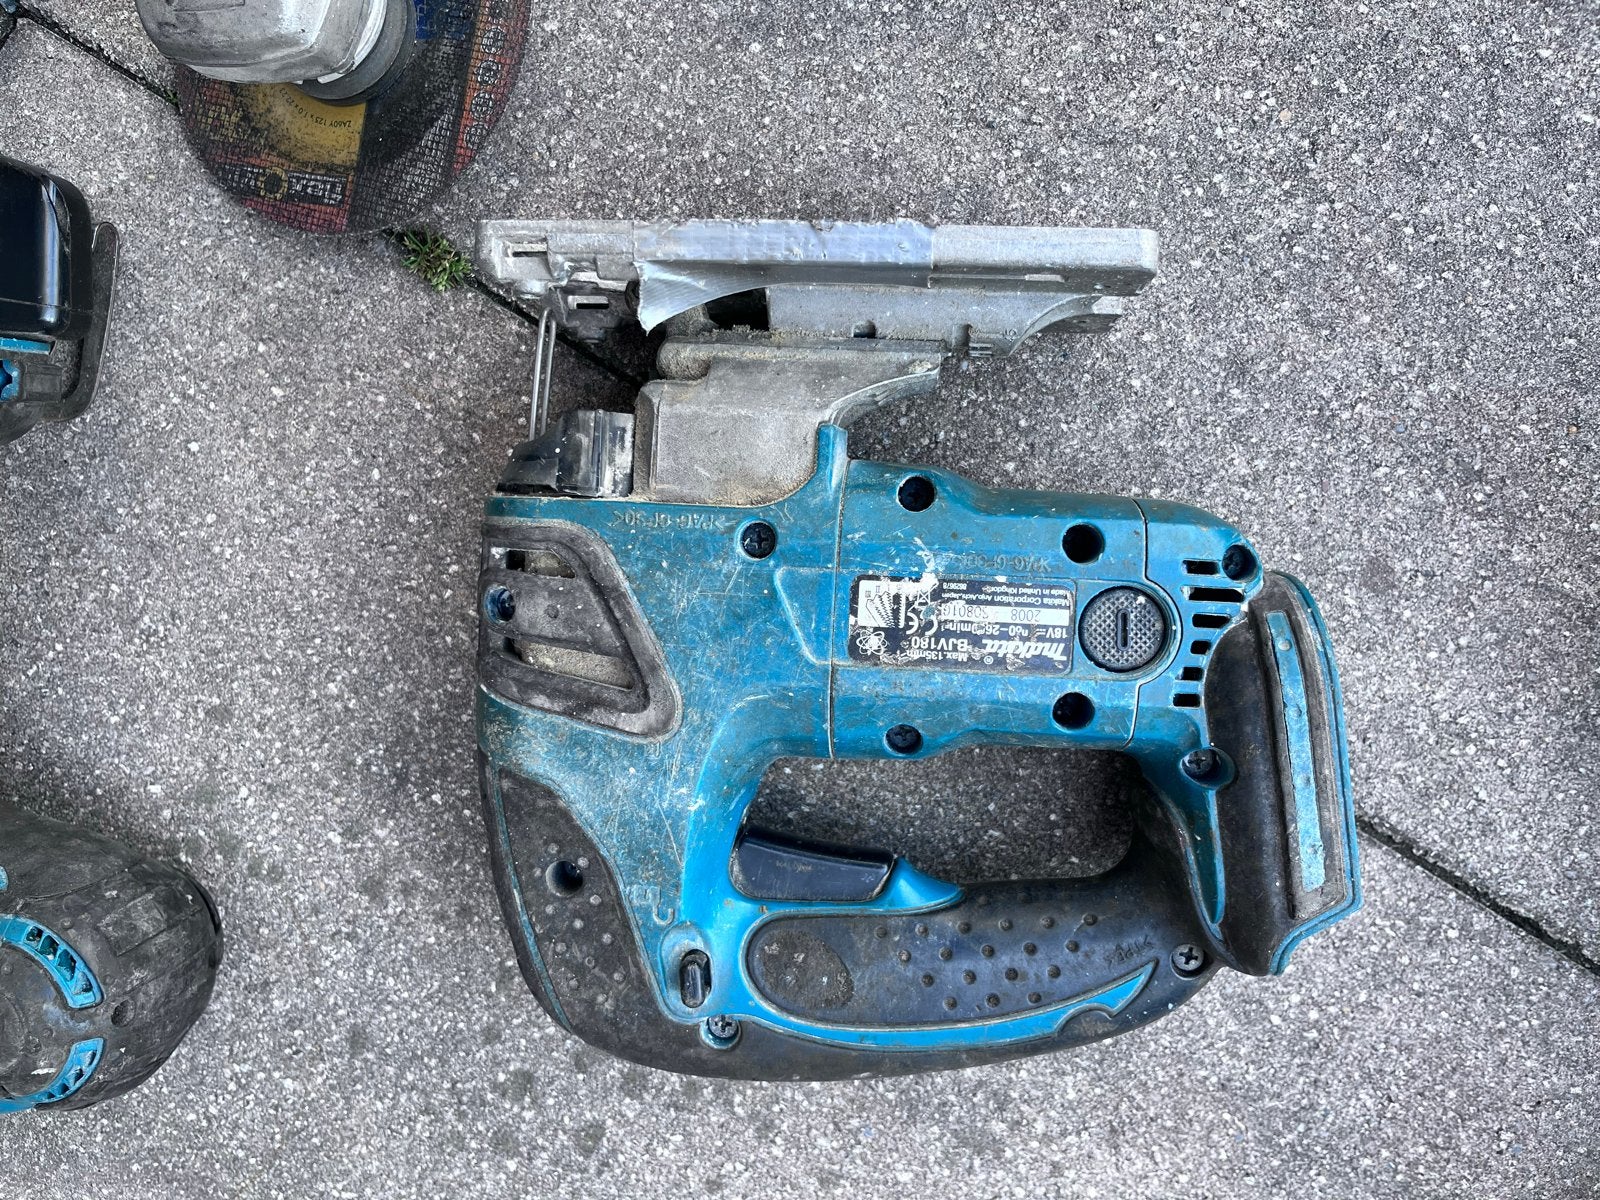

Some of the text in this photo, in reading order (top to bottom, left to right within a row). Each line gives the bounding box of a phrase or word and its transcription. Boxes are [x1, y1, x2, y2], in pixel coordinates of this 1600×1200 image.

[315, 116, 327, 126] 125
[329, 120, 352, 128] ZA60Y
[1018, 587, 1041, 596] United
[994, 594, 1042, 605] Corporation
[1044, 597, 1070, 607] Makita
[1011, 608, 1041, 623] 2008
[910, 636, 968, 651] BJV180
[905, 649, 968, 662] Max.135mm
